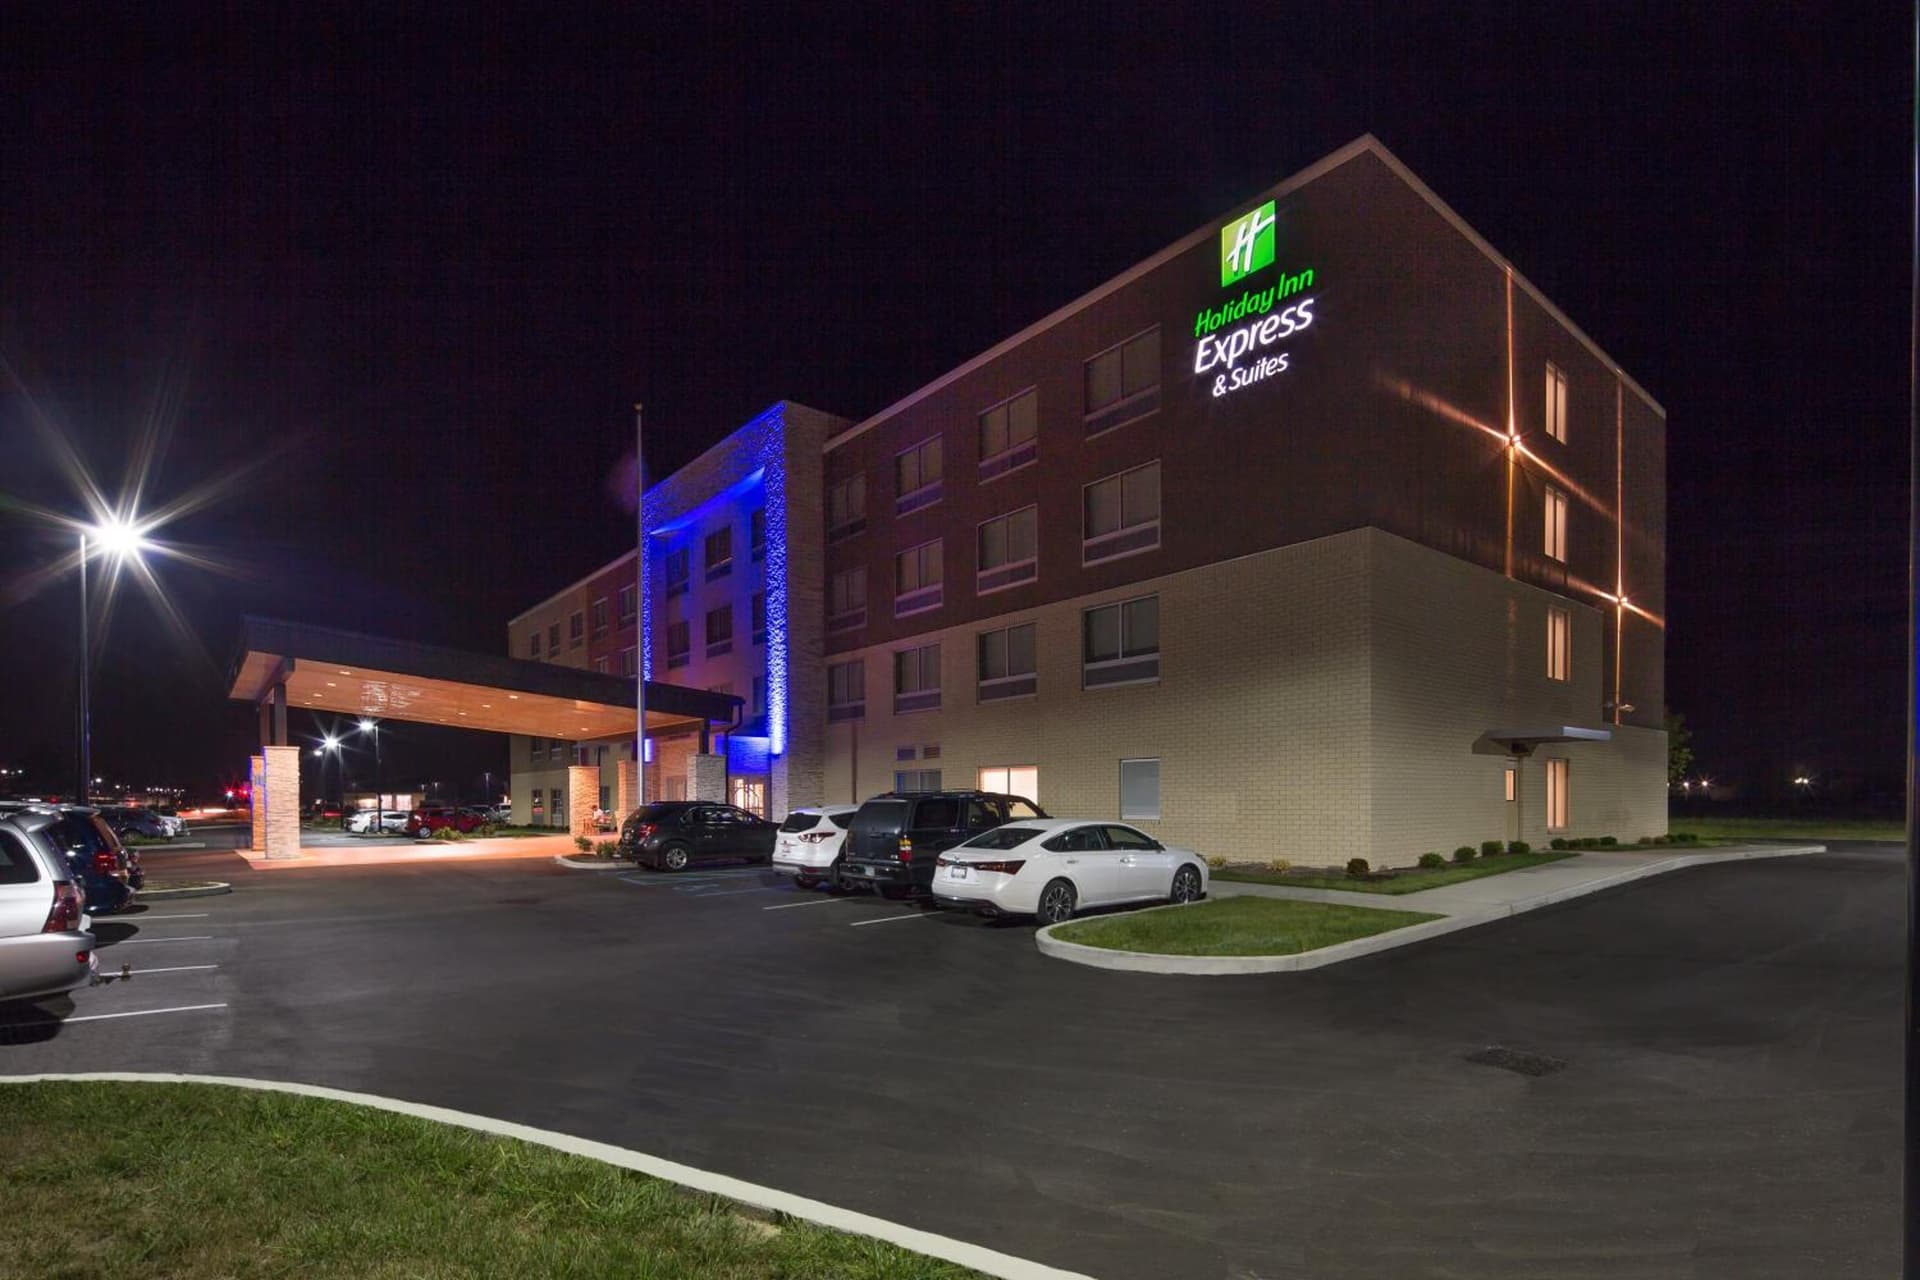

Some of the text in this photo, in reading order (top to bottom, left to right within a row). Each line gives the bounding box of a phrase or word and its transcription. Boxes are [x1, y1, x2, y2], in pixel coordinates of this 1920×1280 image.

[1226, 211, 1275, 272] H
[1195, 268, 1314, 337] Holiday Inn
[1194, 298, 1315, 374] Express
[1212, 353, 1289, 397] & Suites
